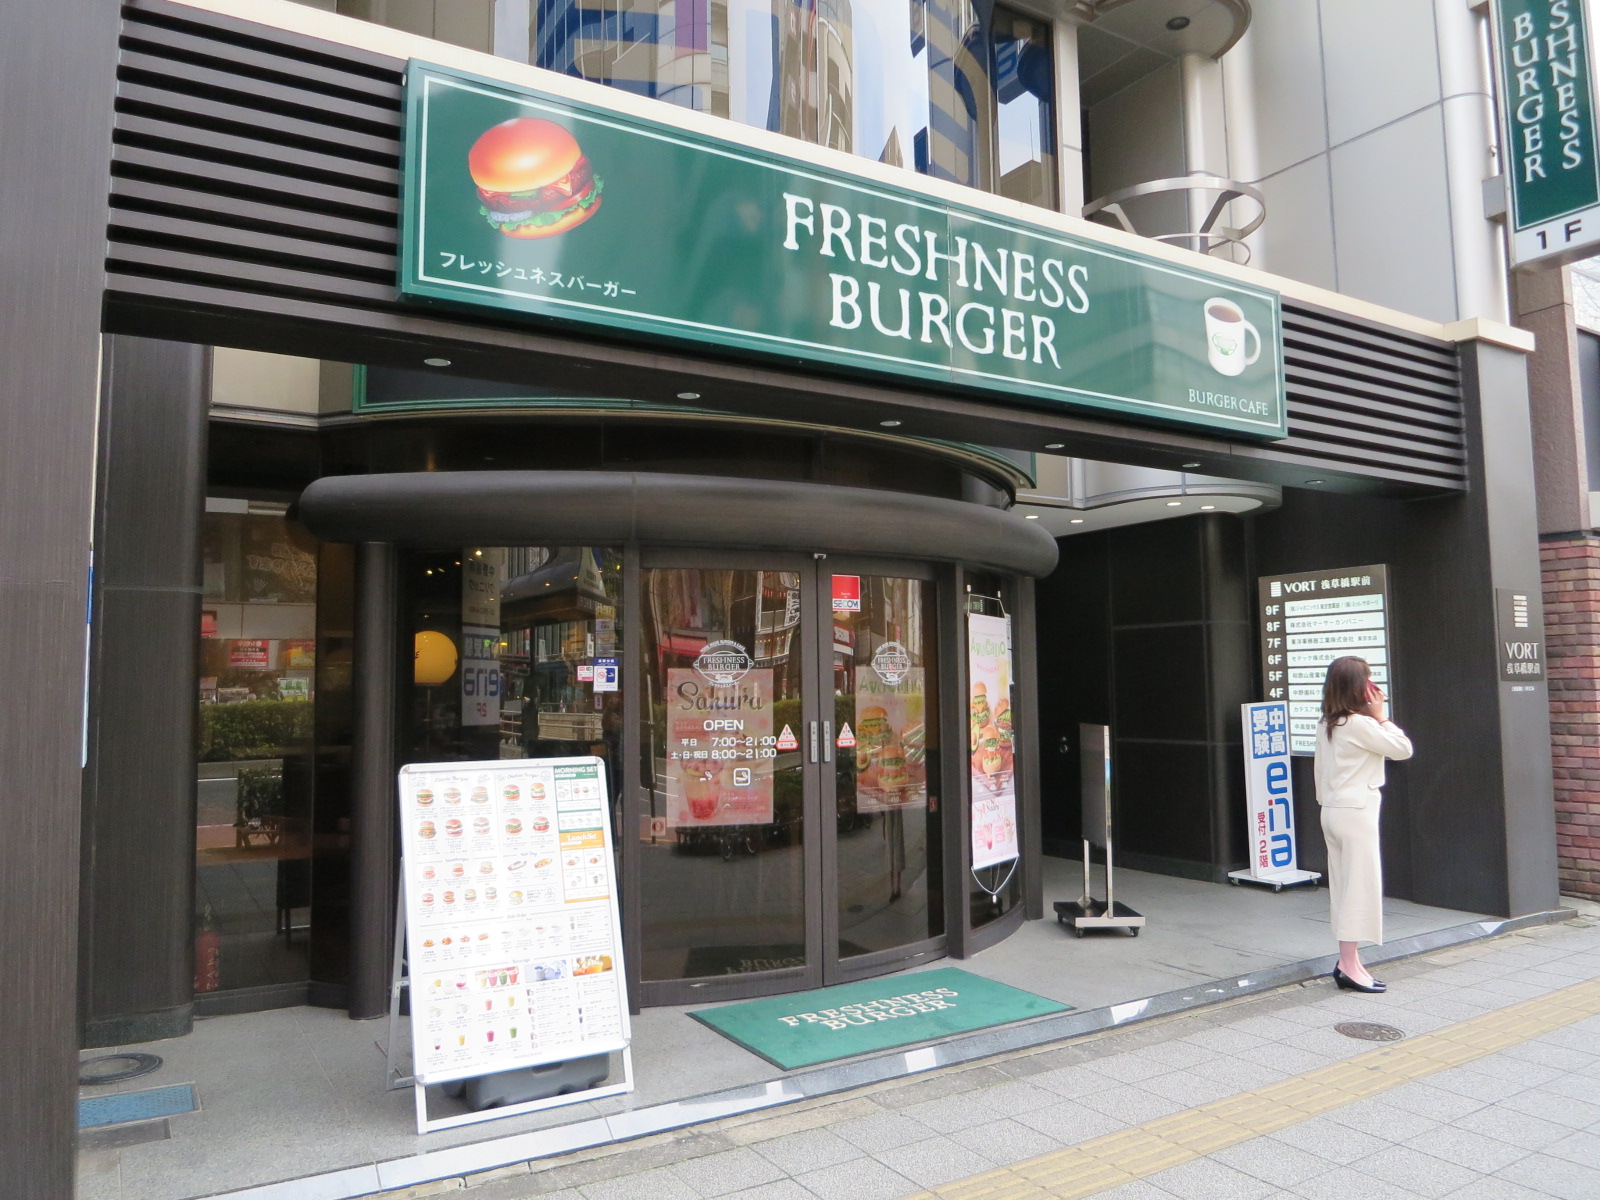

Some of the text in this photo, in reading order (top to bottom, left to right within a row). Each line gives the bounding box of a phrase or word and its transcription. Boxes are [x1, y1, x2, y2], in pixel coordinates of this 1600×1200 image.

[1512, 12, 1546, 183] BURGER
[782, 191, 1090, 315] FRESHNESS
[439, 250, 637, 298] フレッシュネスバーガー
[828, 273, 1062, 369] BURGER
[1188, 388, 1269, 416] BURGER CAFE
[1284, 581, 1317, 594] VORT
[833, 599, 859, 608] SECOM
[1265, 604, 1280, 616] 9F
[1266, 621, 1281, 632] 8F
[1267, 638, 1282, 649] 7F
[1505, 642, 1540, 659] VORT
[703, 656, 745, 664] FRESHNESS
[1267, 654, 1283, 665] 6F
[1268, 671, 1283, 682] 5F
[1269, 687, 1284, 698] 4F
[703, 719, 744, 731] OPEN
[680, 738, 697, 747] 平日
[554, 765, 598, 774] MORNING SET
[777, 987, 960, 1027] FRESHNESS
[820, 998, 957, 1031] BURGER
